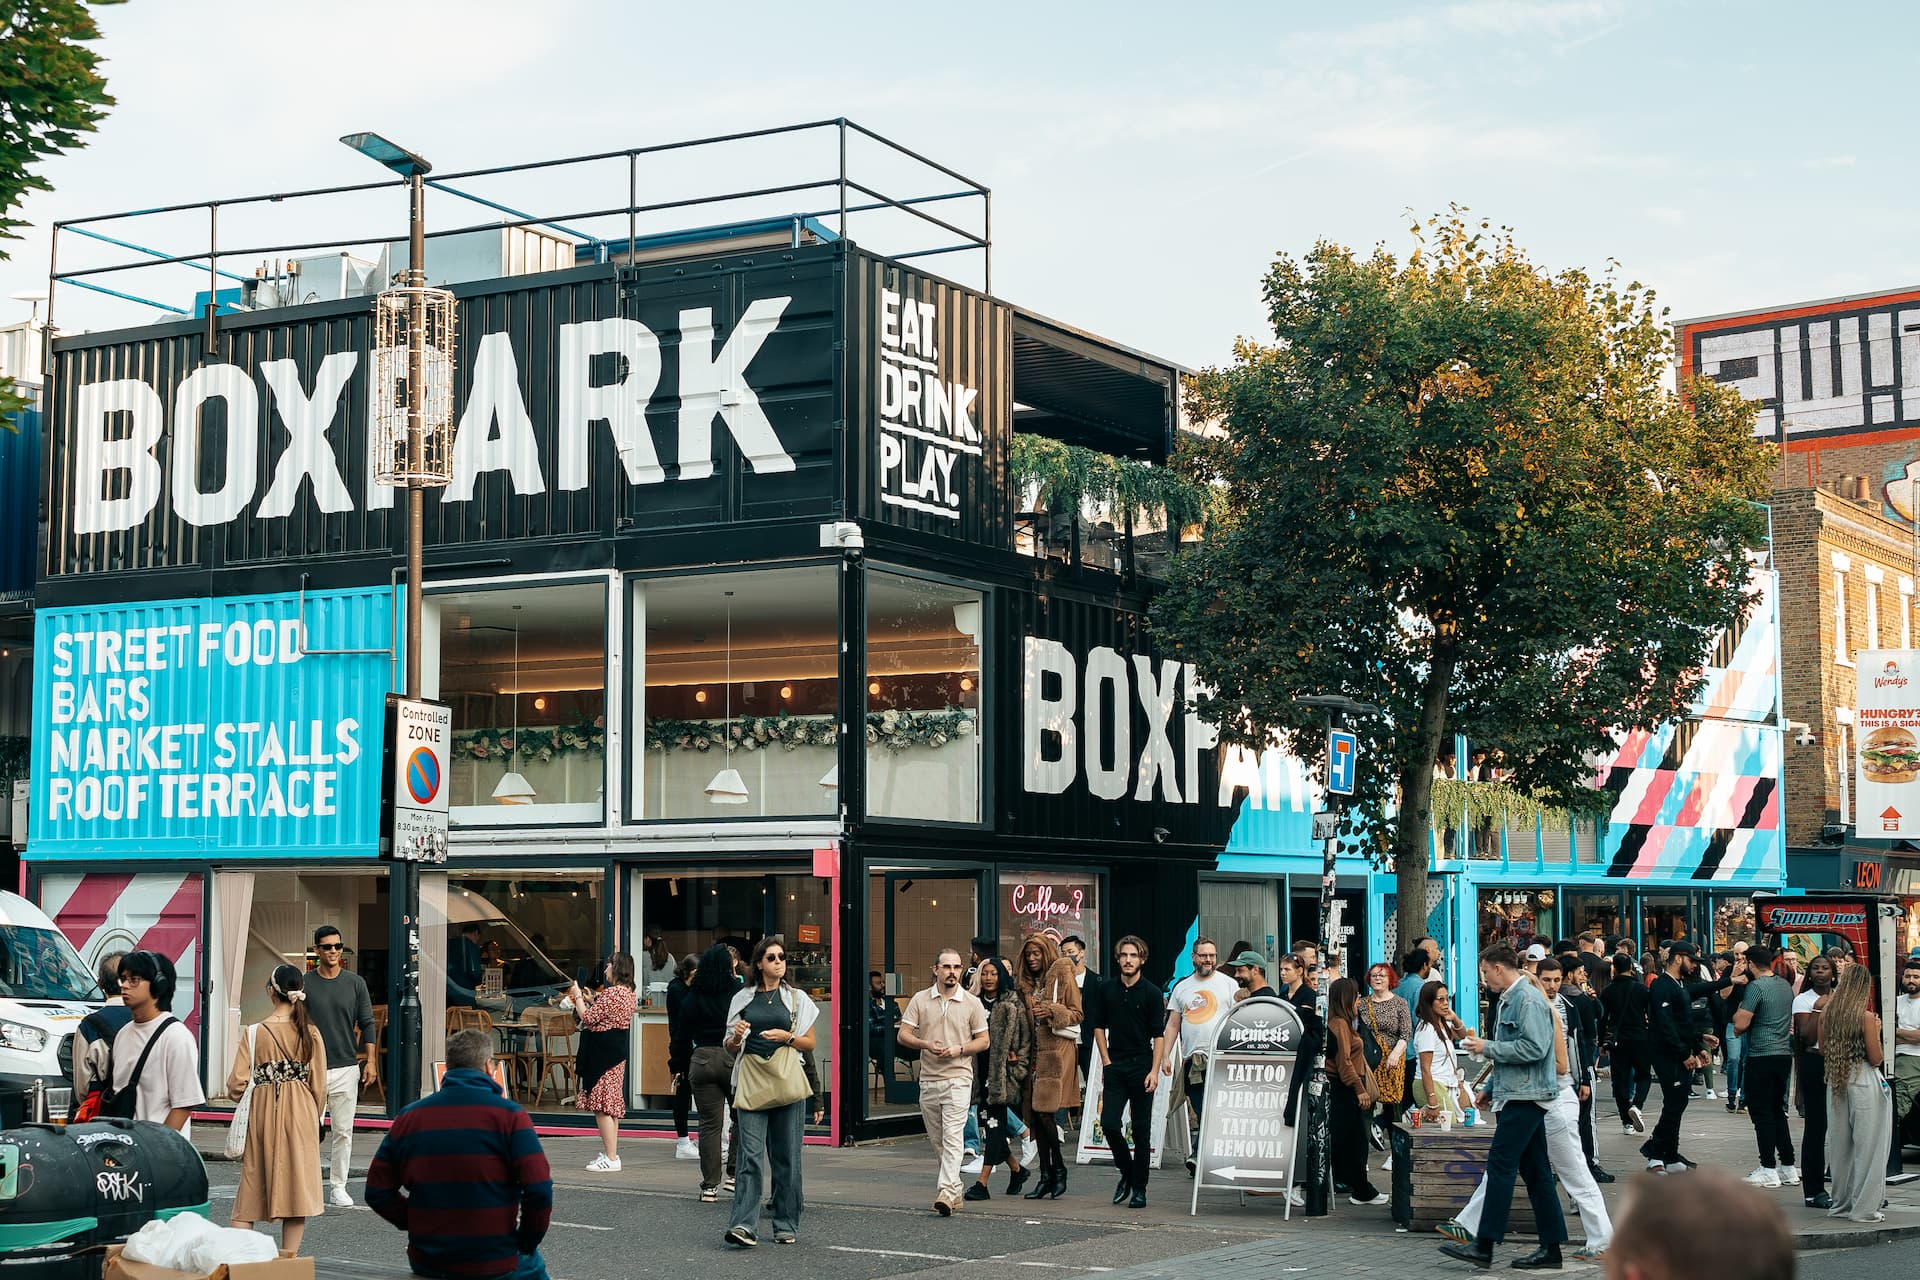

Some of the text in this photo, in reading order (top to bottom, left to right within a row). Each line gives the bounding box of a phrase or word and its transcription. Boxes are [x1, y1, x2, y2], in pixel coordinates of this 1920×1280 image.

[881, 287, 938, 360] EAT.
[881, 432, 960, 507] PLAY.
[53, 618, 308, 677] STREET FOOD
[1874, 675, 1908, 688] Wendy's
[51, 676, 150, 724] BARS
[402, 706, 448, 725] Controlled
[1860, 720, 1880, 728] THIS
[1881, 720, 1890, 728] IS
[1892, 720, 1899, 728] A
[51, 717, 360, 772] MARKET STALLS
[408, 725, 441, 743] ZONE
[49, 771, 337, 822] ROOF TERRACE
[1857, 862, 1882, 888] LEON
[1229, 1027, 1290, 1043] nemesis
[1227, 1063, 1286, 1082] TATTOO
[1221, 1117, 1281, 1137] TATTOO
[1212, 1138, 1284, 1159] REMOVAL
